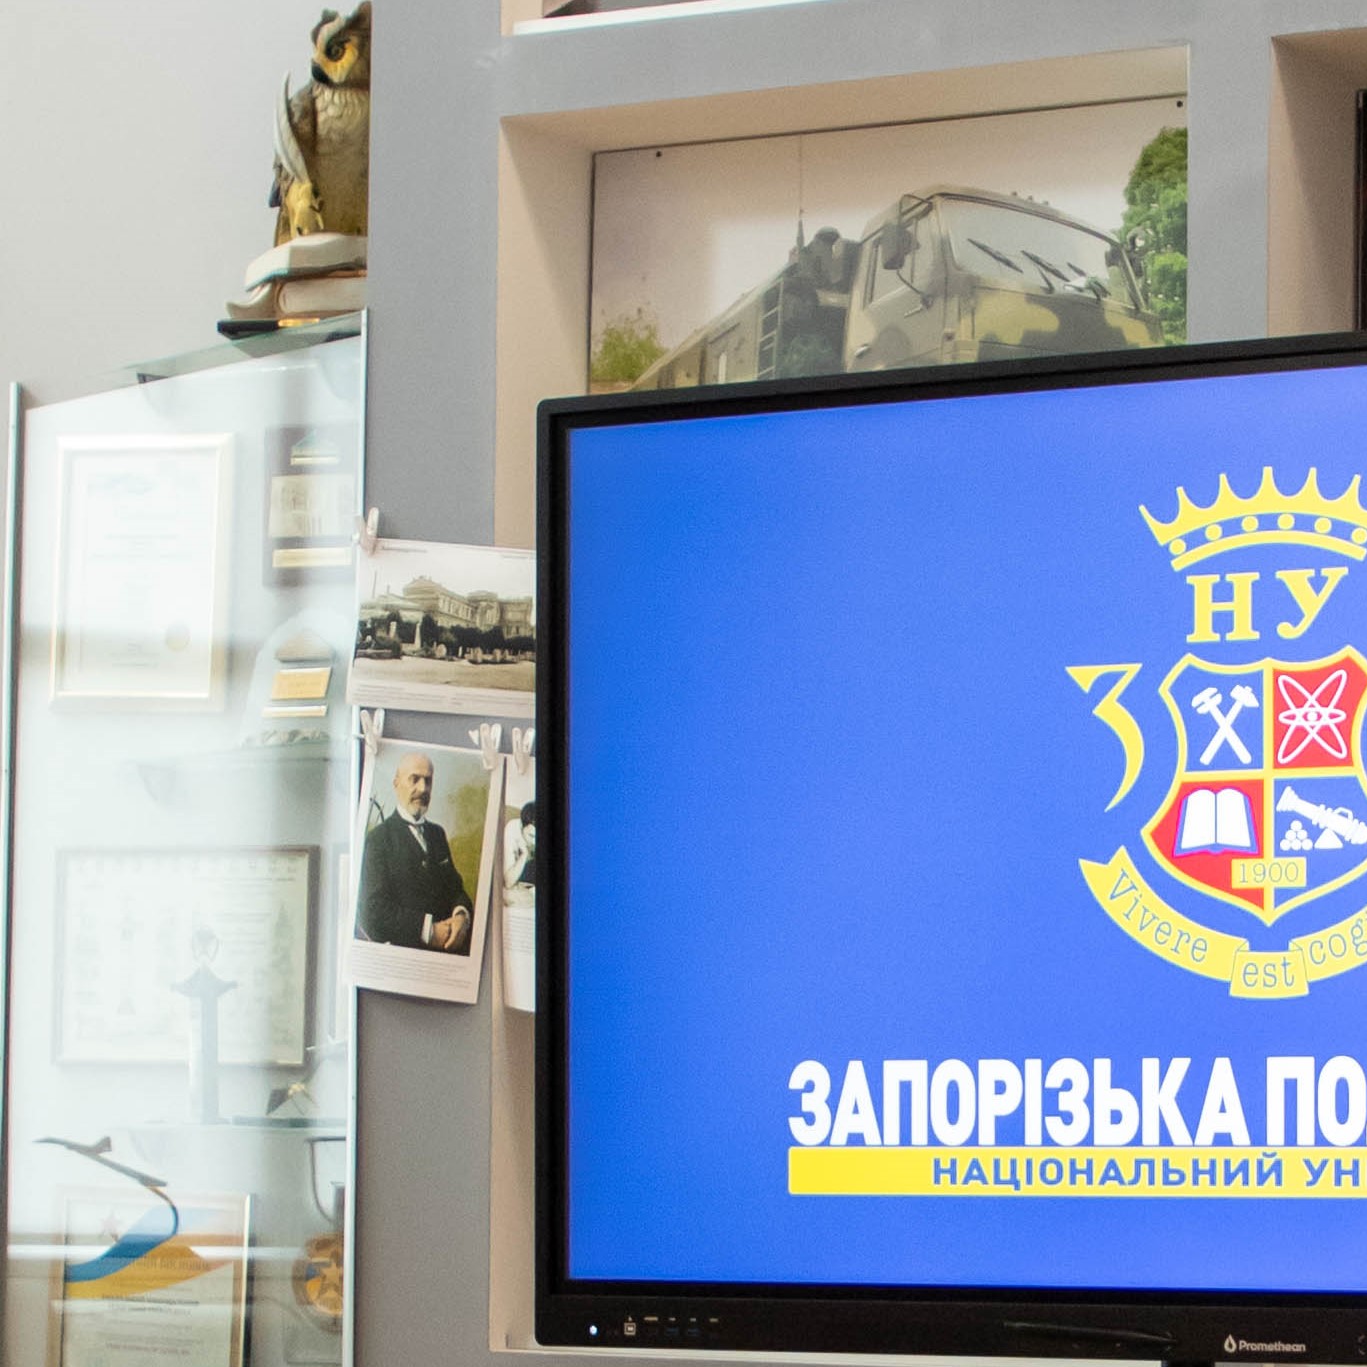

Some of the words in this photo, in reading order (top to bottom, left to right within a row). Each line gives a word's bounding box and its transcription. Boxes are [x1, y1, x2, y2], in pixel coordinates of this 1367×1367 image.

[1238, 861, 1300, 885] 1900
[1107, 868, 1209, 963] Vivere
[1241, 955, 1296, 989] est
[788, 1057, 1250, 1146] ЗАПОРІЗЬКА
[932, 1152, 1285, 1190] НАЦІОНАЛЬНИЙ
[1239, 1340, 1306, 1352] Promethean
